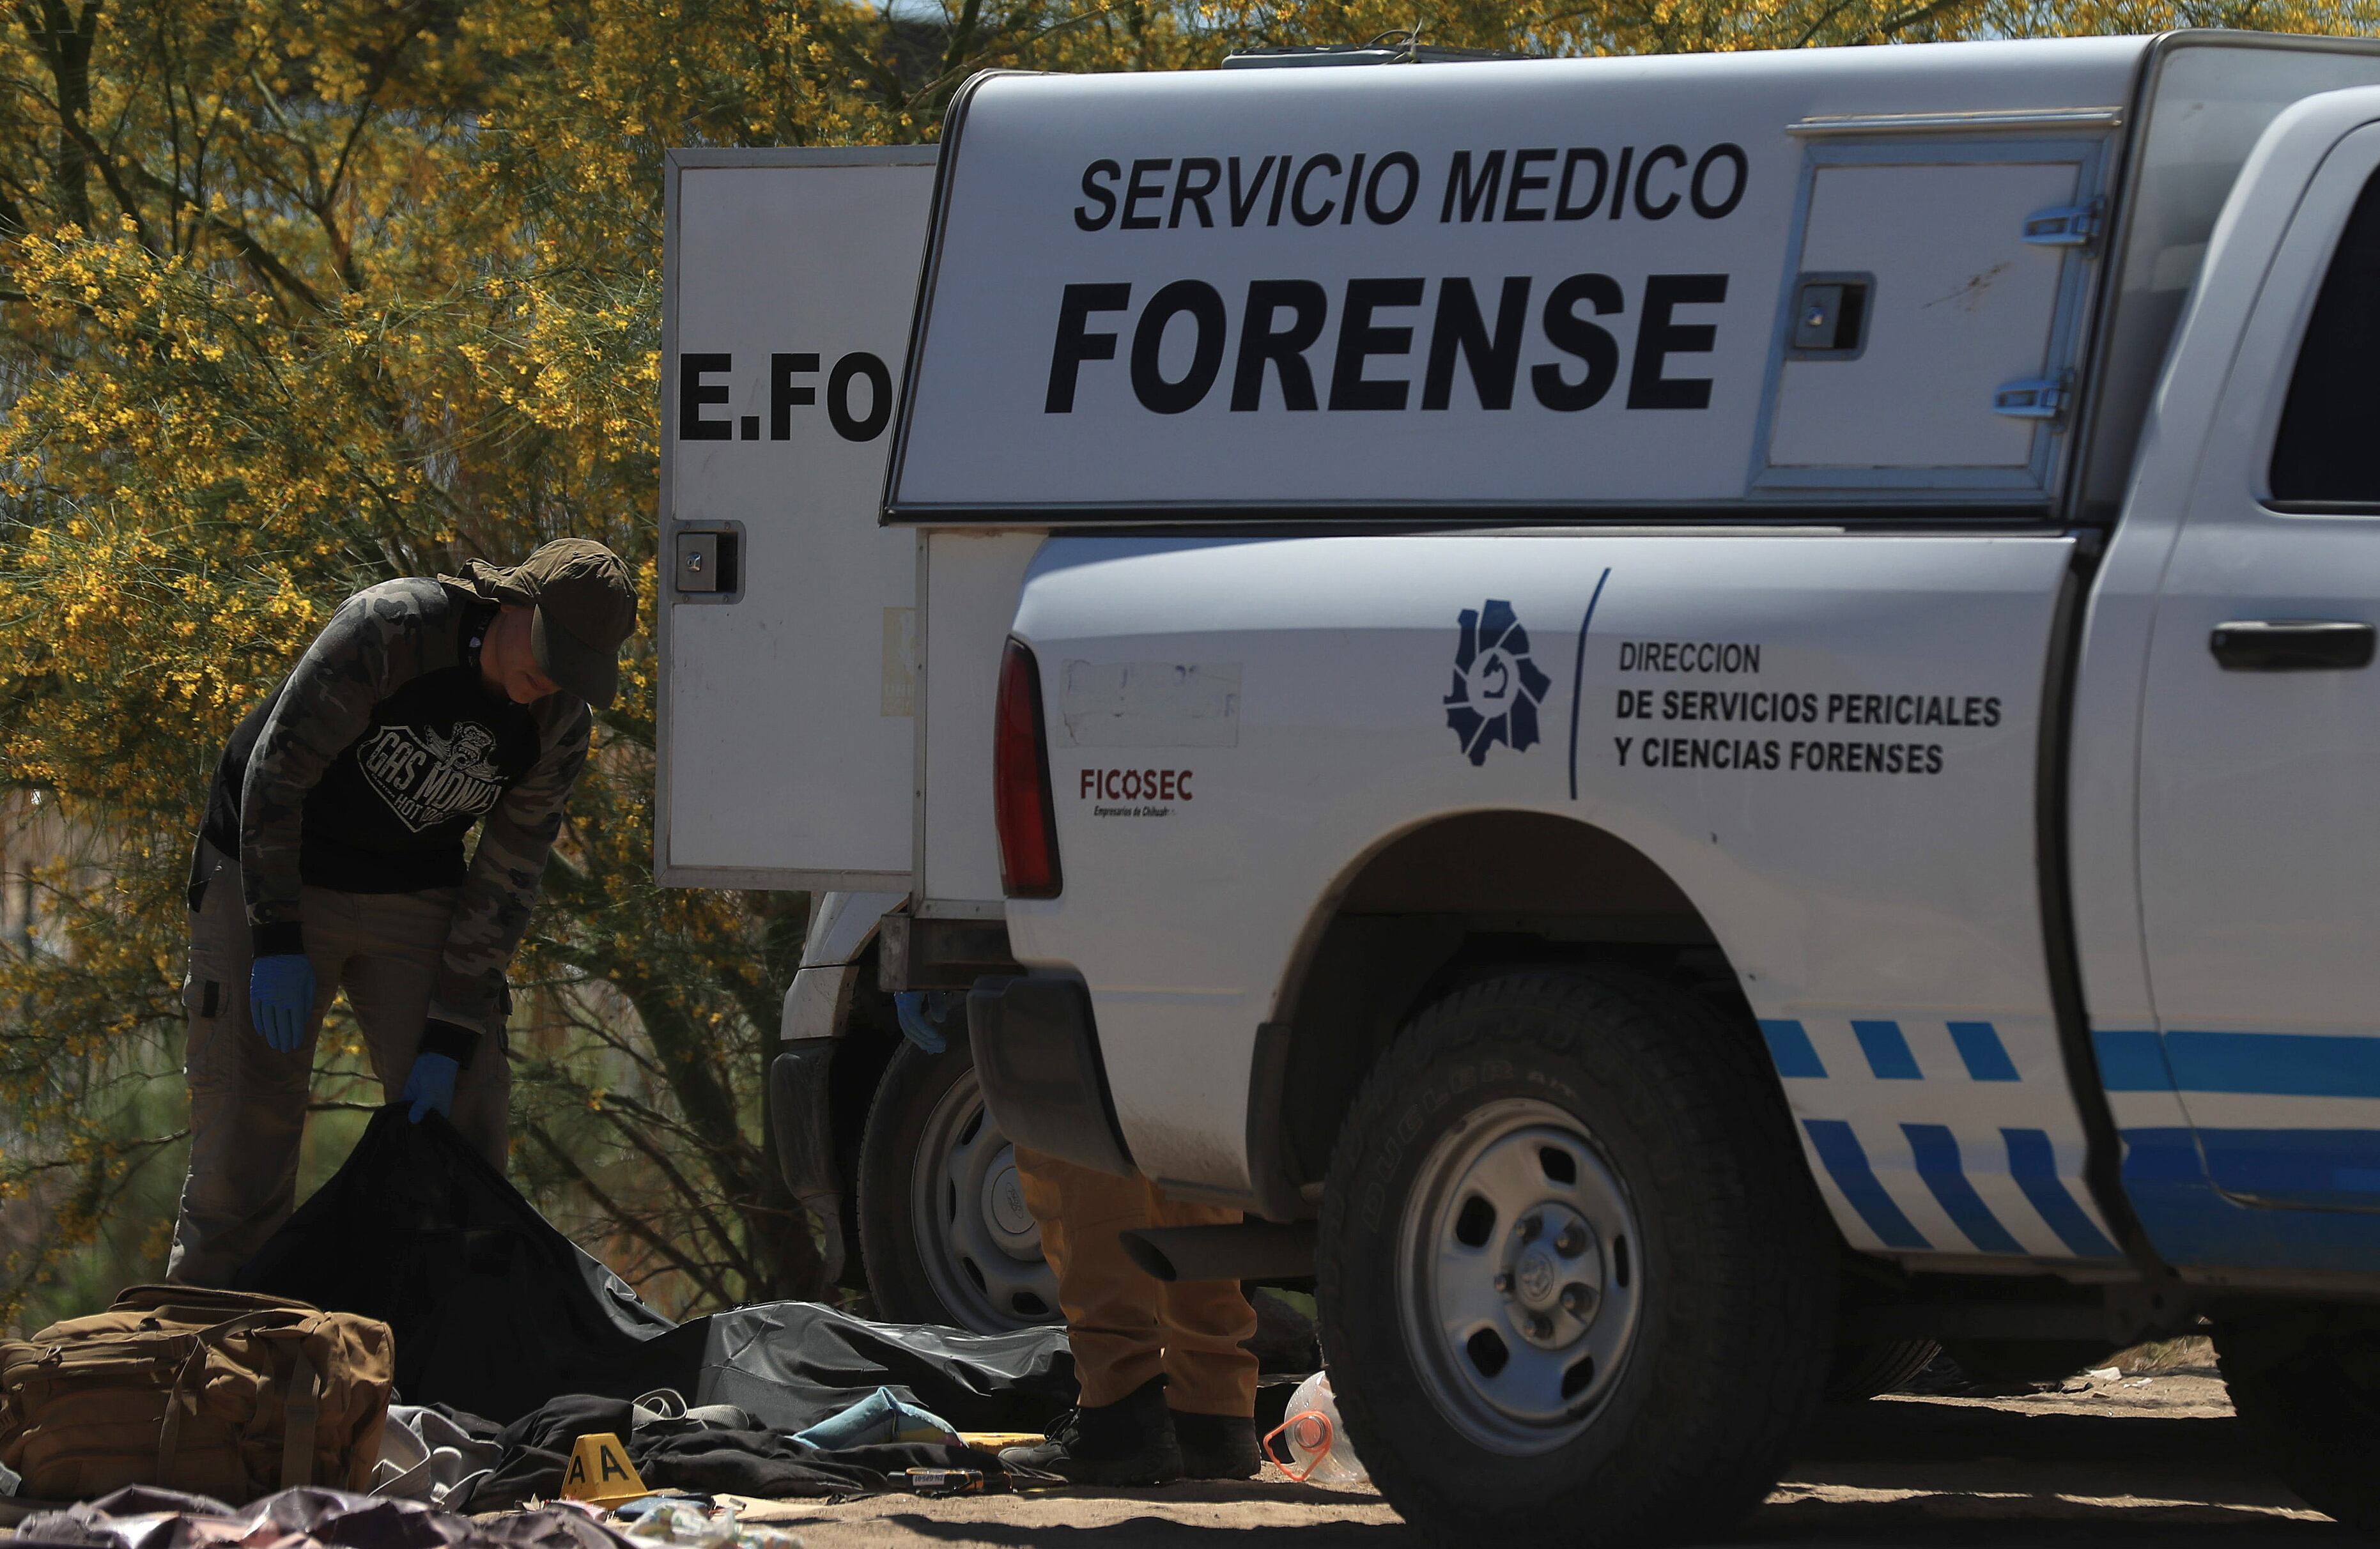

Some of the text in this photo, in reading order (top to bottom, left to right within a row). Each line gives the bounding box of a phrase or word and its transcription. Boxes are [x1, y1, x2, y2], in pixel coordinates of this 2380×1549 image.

[1074, 143, 1749, 232] SERVICIO MEDICO
[1044, 273, 1729, 415] FORENSE
[679, 351, 892, 442] E.FO
[1619, 642, 1760, 674] DIRECCION
[1616, 689, 2002, 728] DE SERVICIOS PERICIALES
[366, 732, 426, 790] GAS
[1614, 736, 1943, 775] Y CIENCIAS FORENSES
[1080, 769, 1193, 801] FICOSEC
[394, 793, 424, 820] HOT
[569, 1444, 630, 1485] A A
